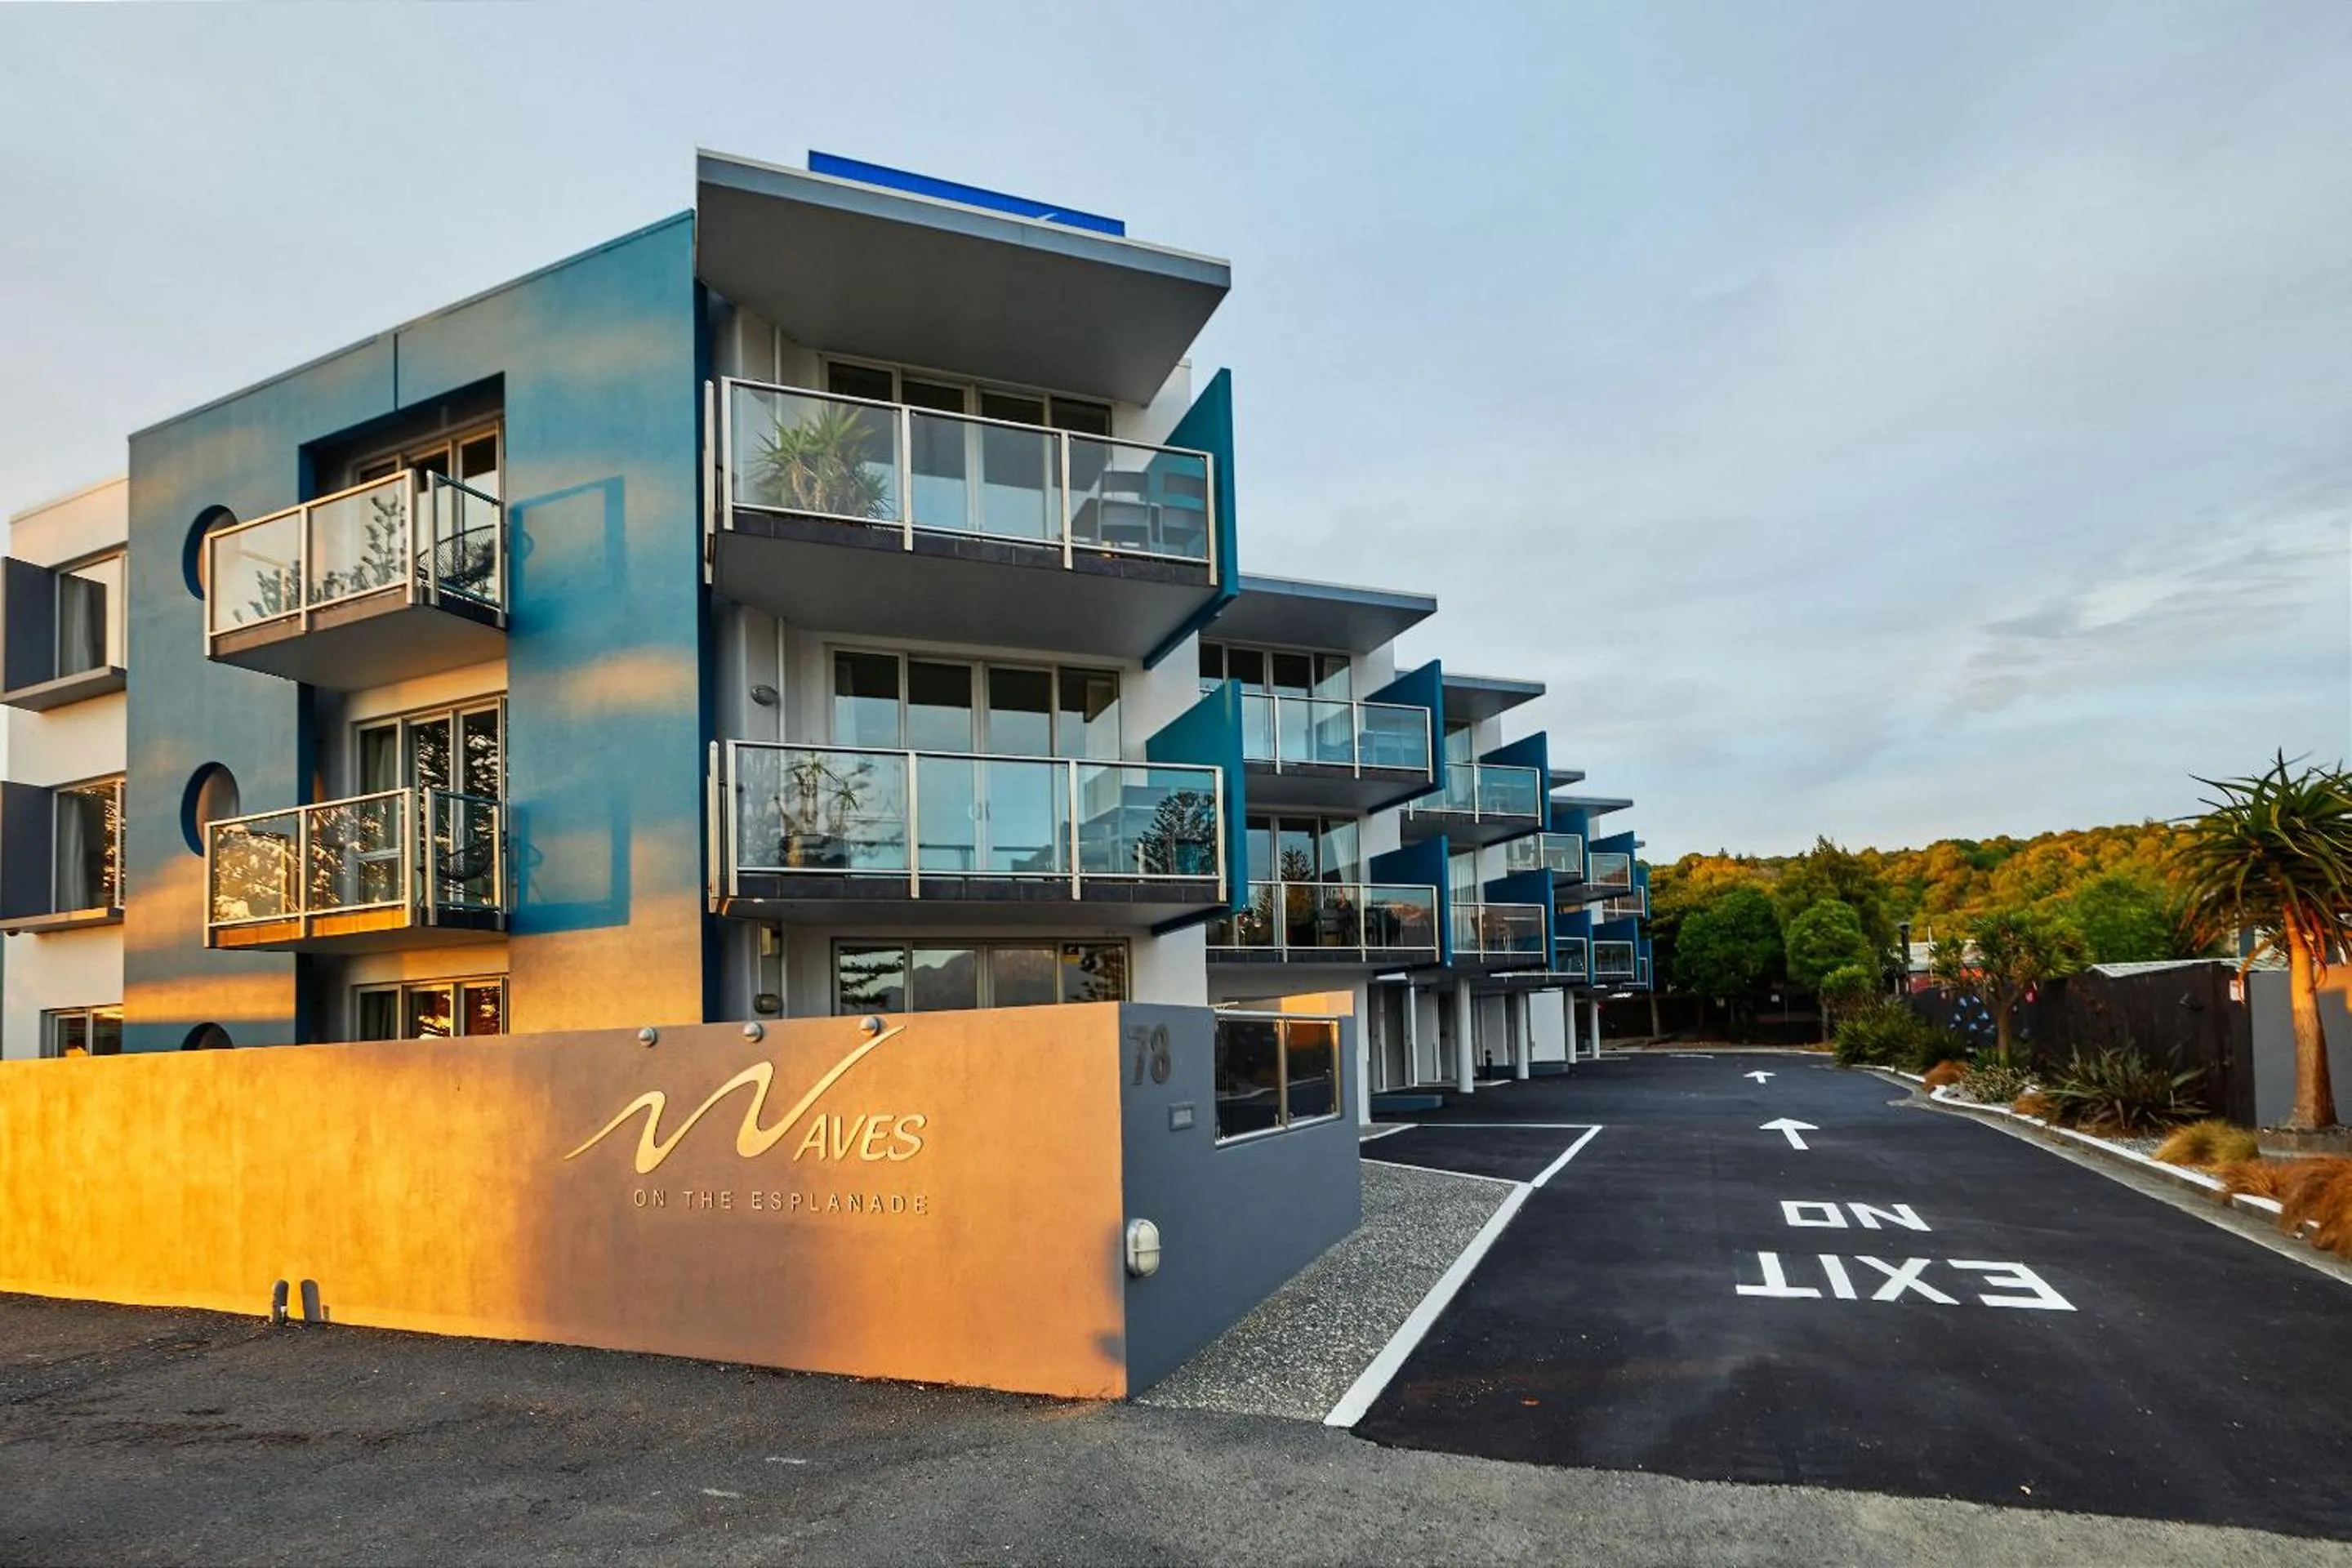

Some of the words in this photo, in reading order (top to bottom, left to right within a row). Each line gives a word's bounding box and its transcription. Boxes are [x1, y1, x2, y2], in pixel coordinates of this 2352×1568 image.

[1127, 1023, 1171, 1085] 78
[633, 1188, 666, 1209] ON
[684, 1190, 733, 1210] THE
[751, 1191, 929, 1215] ESPLANADE
[1780, 1200, 1932, 1231] NO
[1735, 1251, 2078, 1311] EXIT
